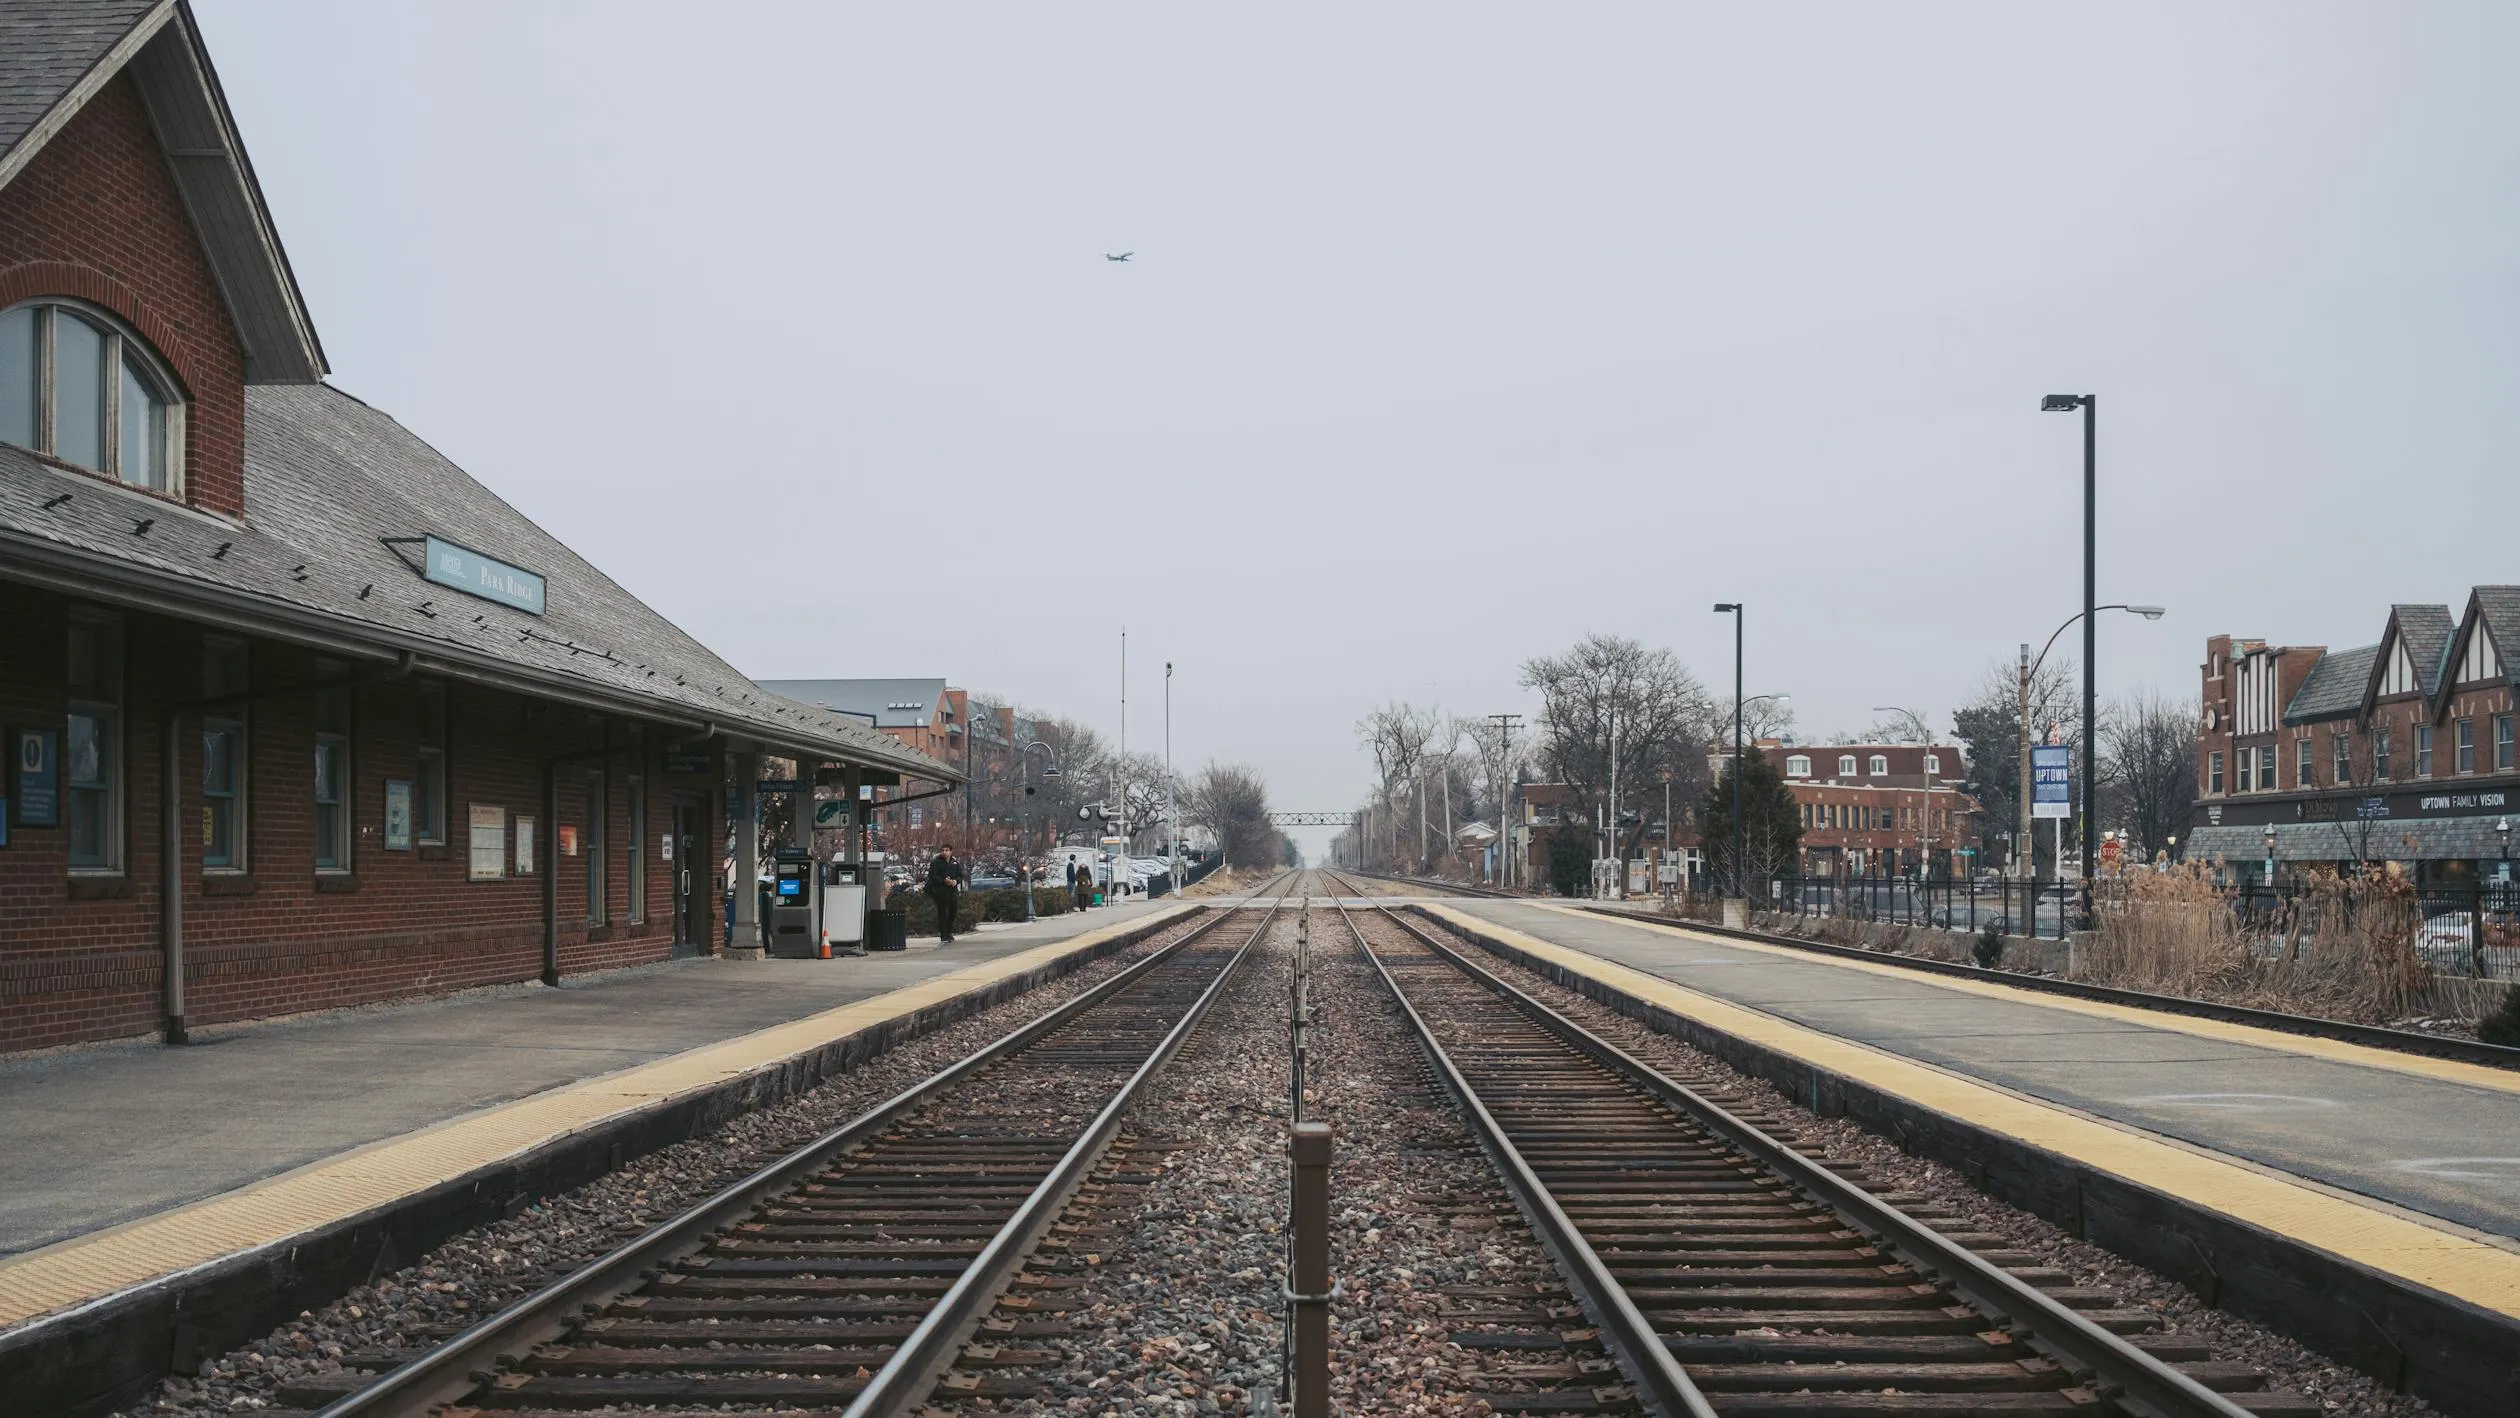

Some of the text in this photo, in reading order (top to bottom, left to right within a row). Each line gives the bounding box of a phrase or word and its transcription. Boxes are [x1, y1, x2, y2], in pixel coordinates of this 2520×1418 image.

[2035, 768, 2068, 782] UPTOWN
[2421, 793, 2505, 810] UPTOWN FAMILY VISION
